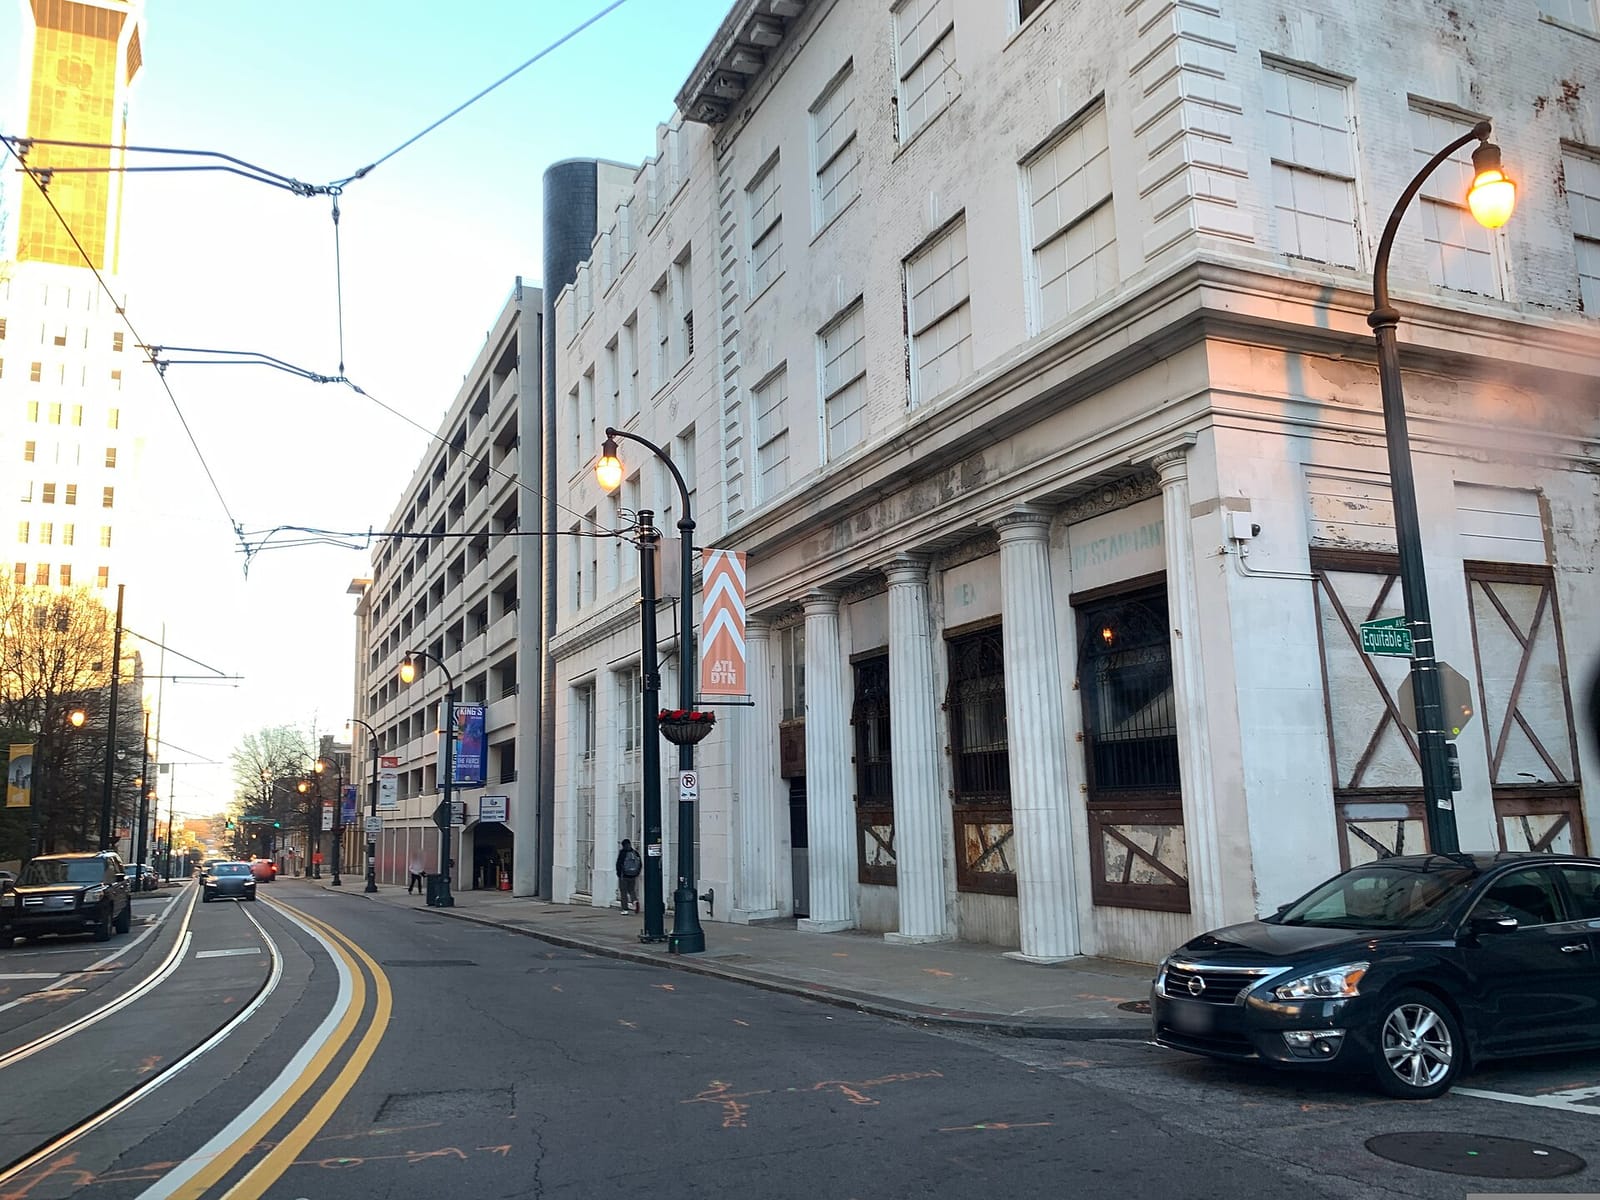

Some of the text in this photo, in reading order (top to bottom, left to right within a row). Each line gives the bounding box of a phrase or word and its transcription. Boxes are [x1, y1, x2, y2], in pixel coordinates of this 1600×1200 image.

[1395, 618, 1406, 627] AVE
[1363, 629, 1402, 651] Equitable
[712, 660, 736, 672] ATL
[711, 672, 736, 684] DTN
[460, 707, 483, 716] KING'S
